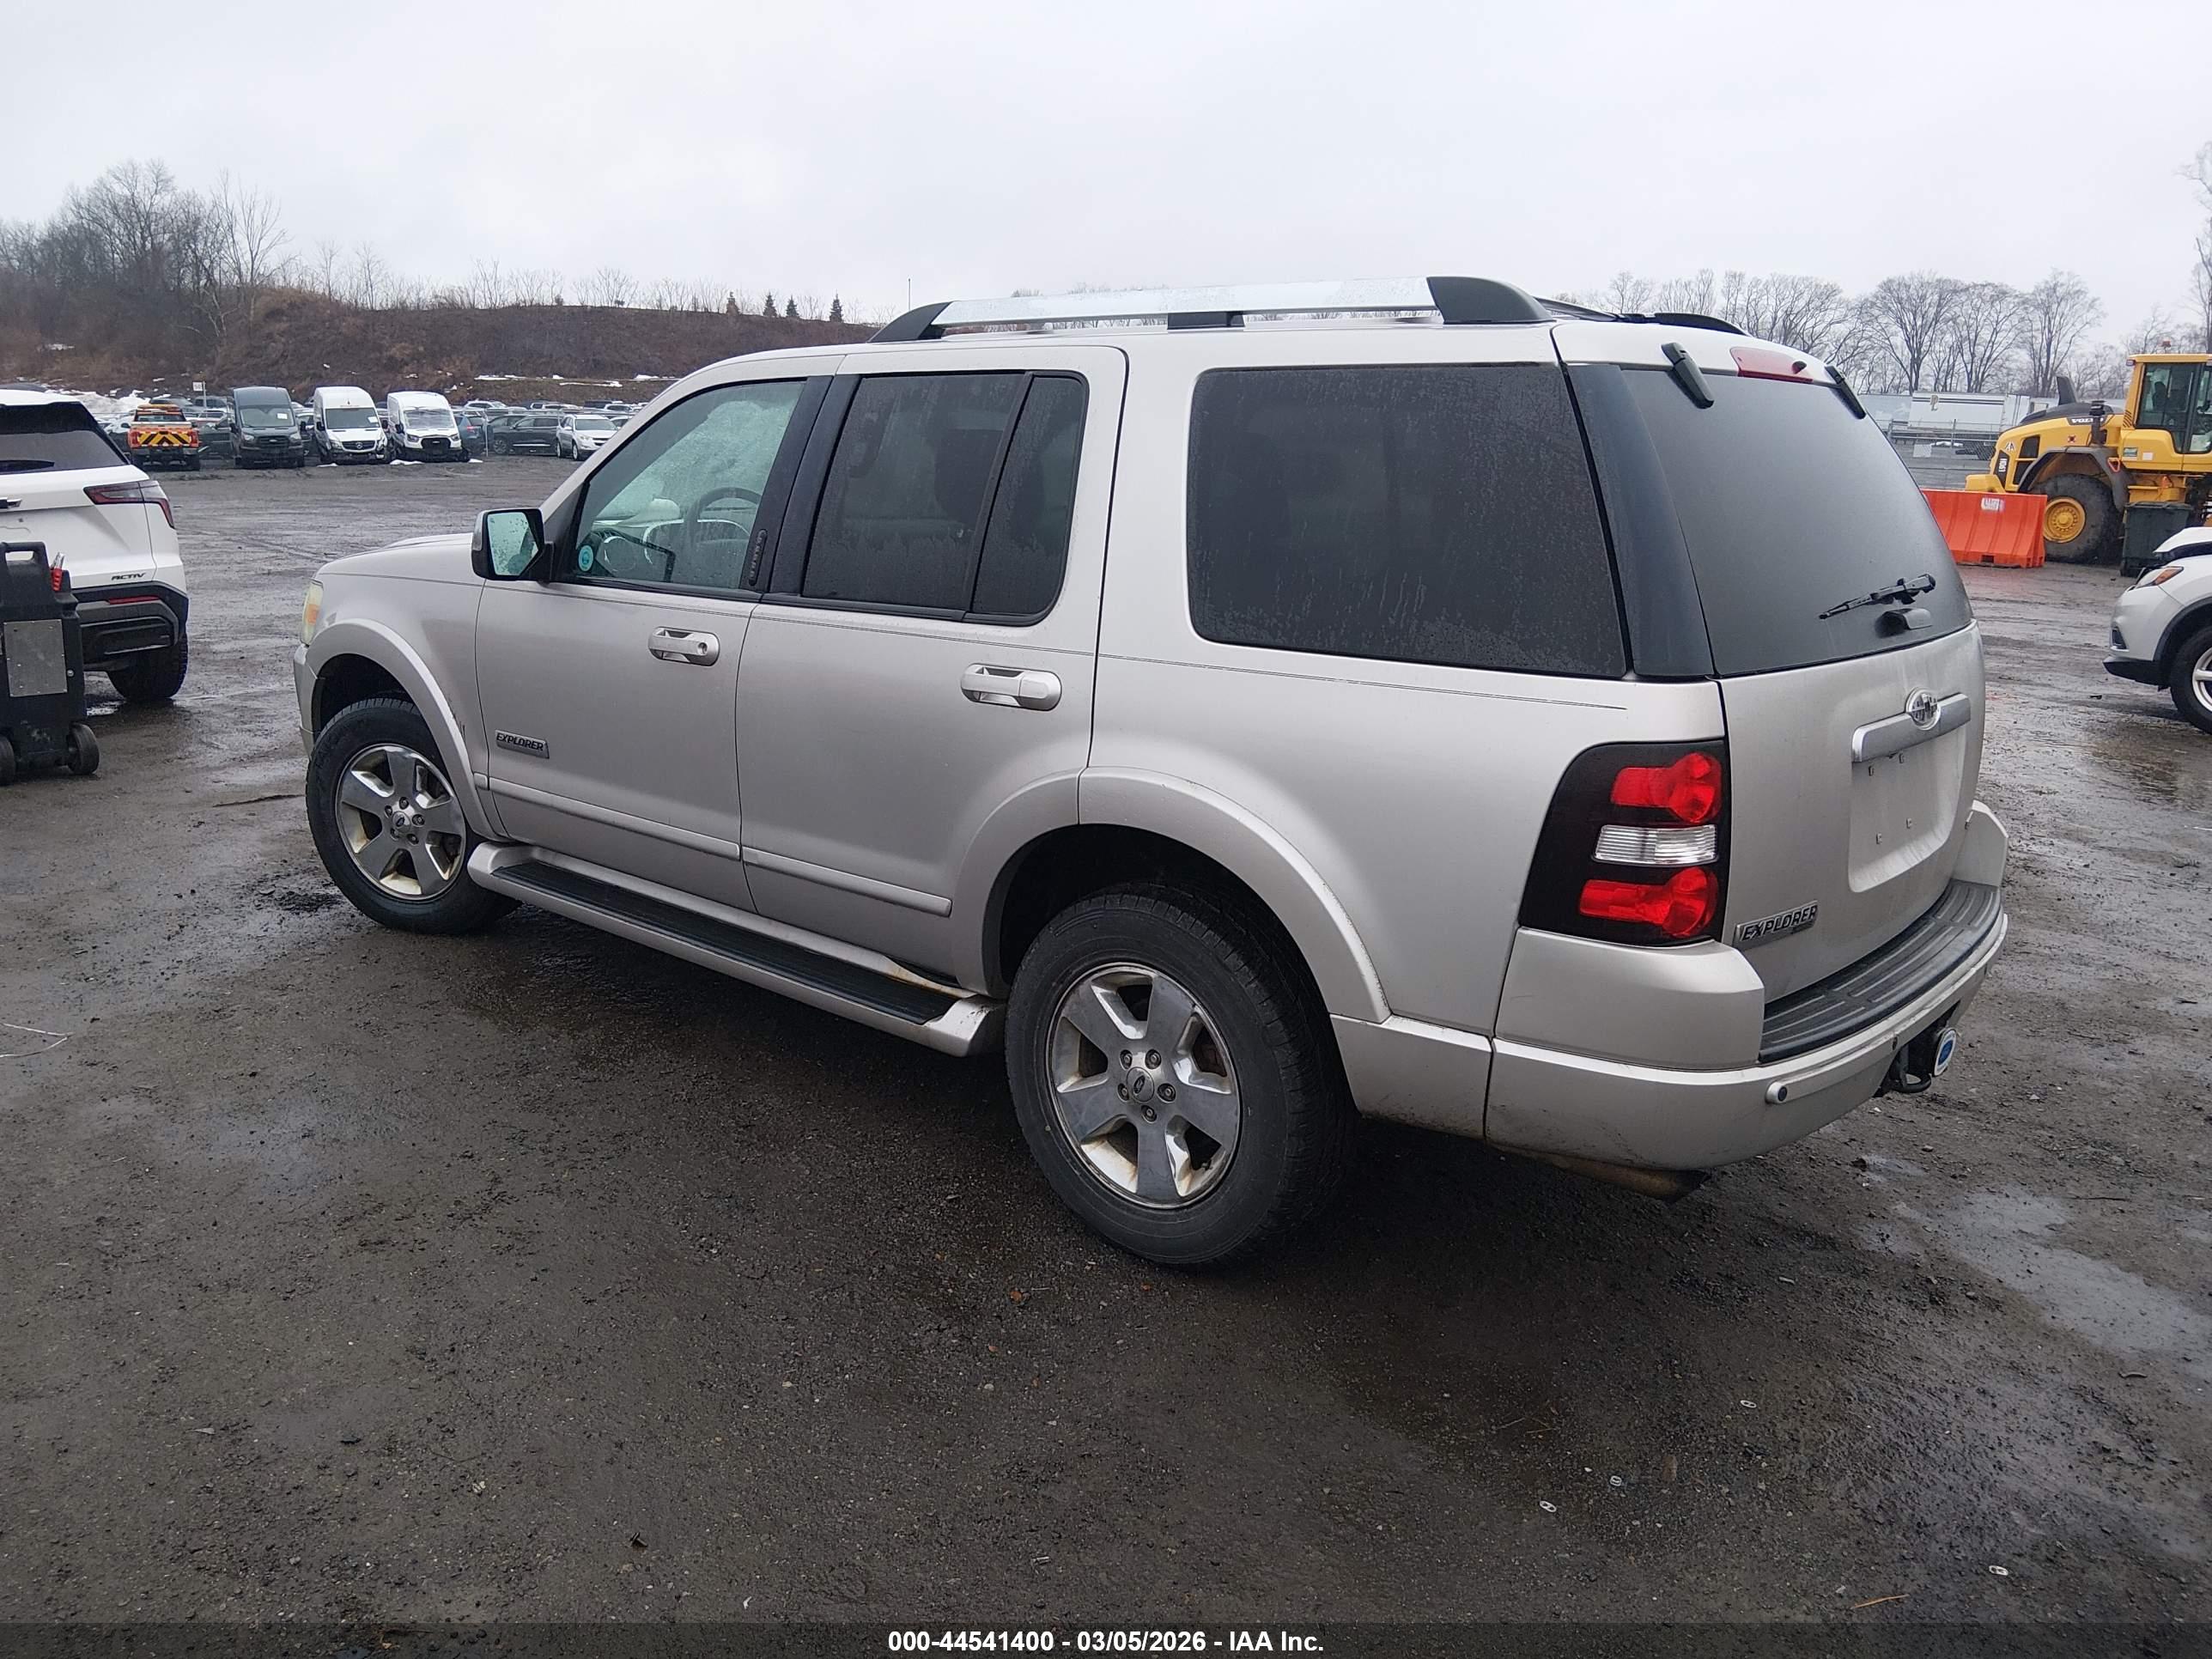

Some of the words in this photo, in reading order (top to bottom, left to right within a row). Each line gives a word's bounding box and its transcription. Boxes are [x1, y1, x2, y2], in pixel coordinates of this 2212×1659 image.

[111, 572, 147, 580] ACTIV
[496, 732, 544, 751] EXPLORER
[1741, 904, 1818, 941] EXPLORER
